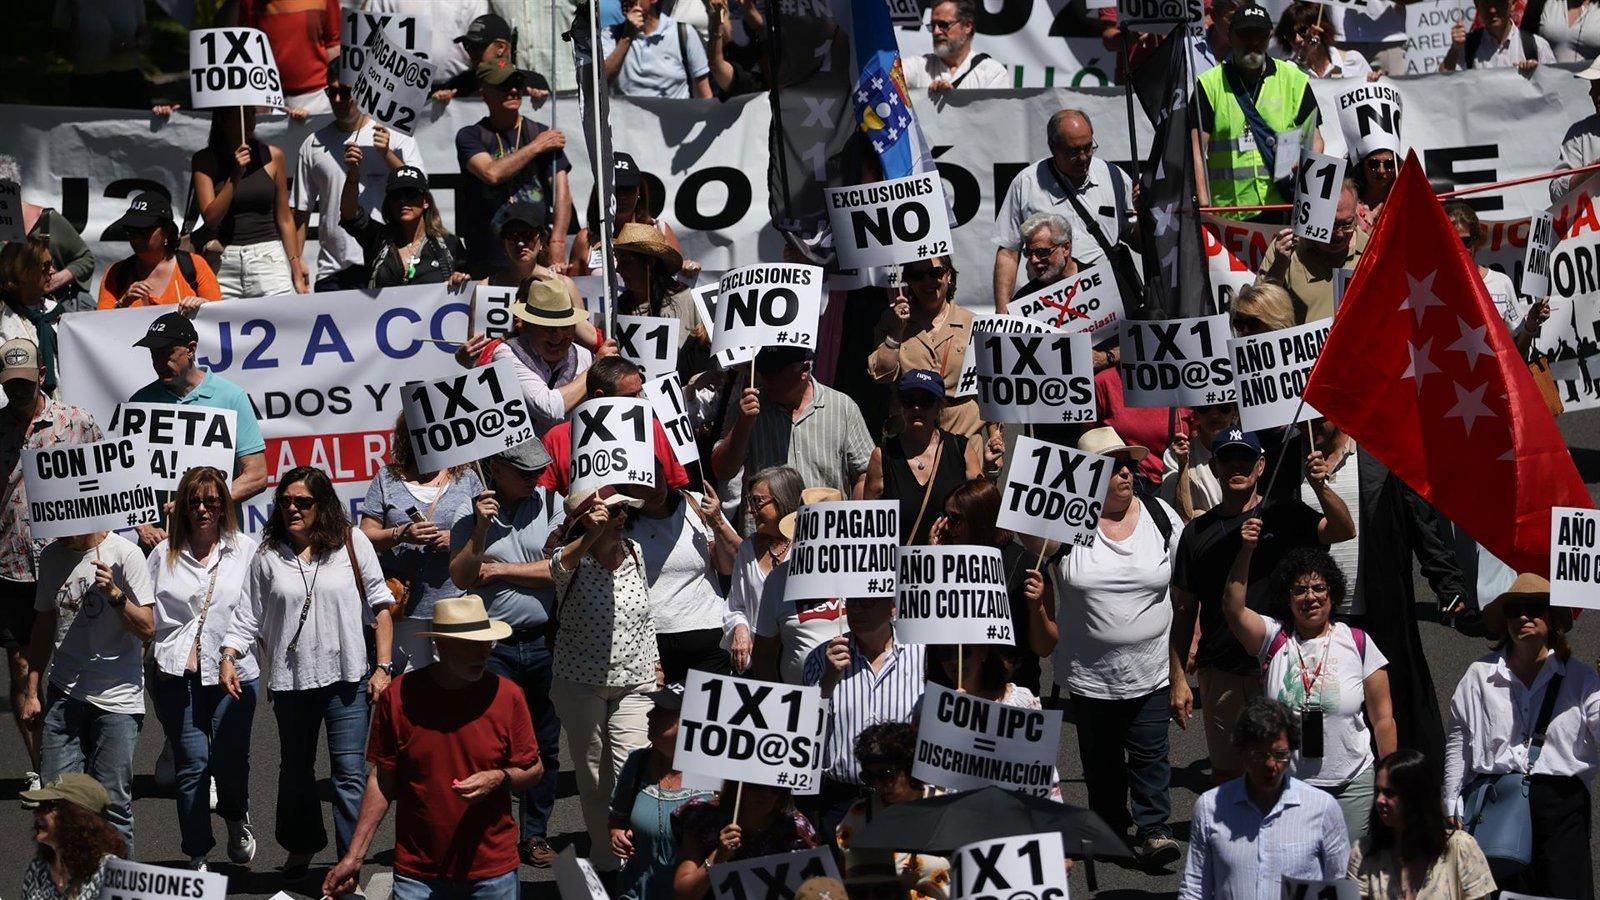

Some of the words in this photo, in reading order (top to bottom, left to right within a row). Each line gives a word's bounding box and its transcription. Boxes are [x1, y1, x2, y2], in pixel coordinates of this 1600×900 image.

[200, 28, 269, 66] 1X1
[346, 11, 416, 51] 1X1
[192, 66, 280, 93] TOD@S
[368, 66, 382, 84] con
[383, 77, 396, 93] la
[266, 95, 284, 106] #J2
[831, 177, 934, 209] EXCLUSIONES
[850, 201, 931, 250] NO
[1305, 223, 1329, 240] #J2
[917, 241, 949, 258] #J2
[720, 266, 813, 295] EXCLUSIONES
[1079, 272, 1103, 293] DE
[724, 286, 800, 332] NO
[301, 313, 355, 366] A
[776, 330, 811, 346] #J2
[984, 335, 1074, 376] 1X1
[1128, 320, 1214, 362] 1X1
[1122, 357, 1234, 391] TOD@S
[1235, 338, 1276, 376] AÑO
[364, 382, 392, 412] Y
[411, 366, 505, 424] 1X1
[976, 374, 1093, 407] TOD@S
[1205, 388, 1237, 404] #J2
[1241, 371, 1279, 408] AÑO
[411, 398, 527, 456] TOD@S
[1061, 408, 1094, 422] #J2
[504, 427, 533, 448] #J2
[36, 447, 88, 480] CON
[92, 439, 135, 474] IPC
[148, 448, 179, 480] A!
[627, 469, 654, 485] #J2
[1031, 445, 1106, 499] 1X1
[31, 483, 156, 523] DISCRIMINACIÓN
[126, 509, 158, 527] #J2
[1008, 481, 1102, 531] TOD@S
[795, 507, 820, 544] AÑO
[824, 508, 897, 539] PAGADO
[1073, 531, 1095, 549] #J2
[1557, 511, 1596, 549] AÑO
[788, 541, 814, 577] AÑO
[817, 543, 897, 574] COTIZADO
[899, 549, 936, 585] AÑO
[941, 553, 1005, 587] PAGADO
[1555, 546, 1591, 583] AÑO
[867, 577, 895, 594] #J2
[898, 584, 931, 620] AÑO
[935, 588, 1011, 621] COTIZADO
[986, 624, 1012, 641] #J2
[701, 678, 804, 733] 1X1
[937, 691, 990, 734] CON
[996, 707, 1045, 743] IPC
[681, 718, 812, 769] TOD@S
[776, 771, 808, 788] #J2
[917, 739, 1053, 787] DISCRIMINACIÓN
[104, 867, 205, 899] EXCLUSIONES
